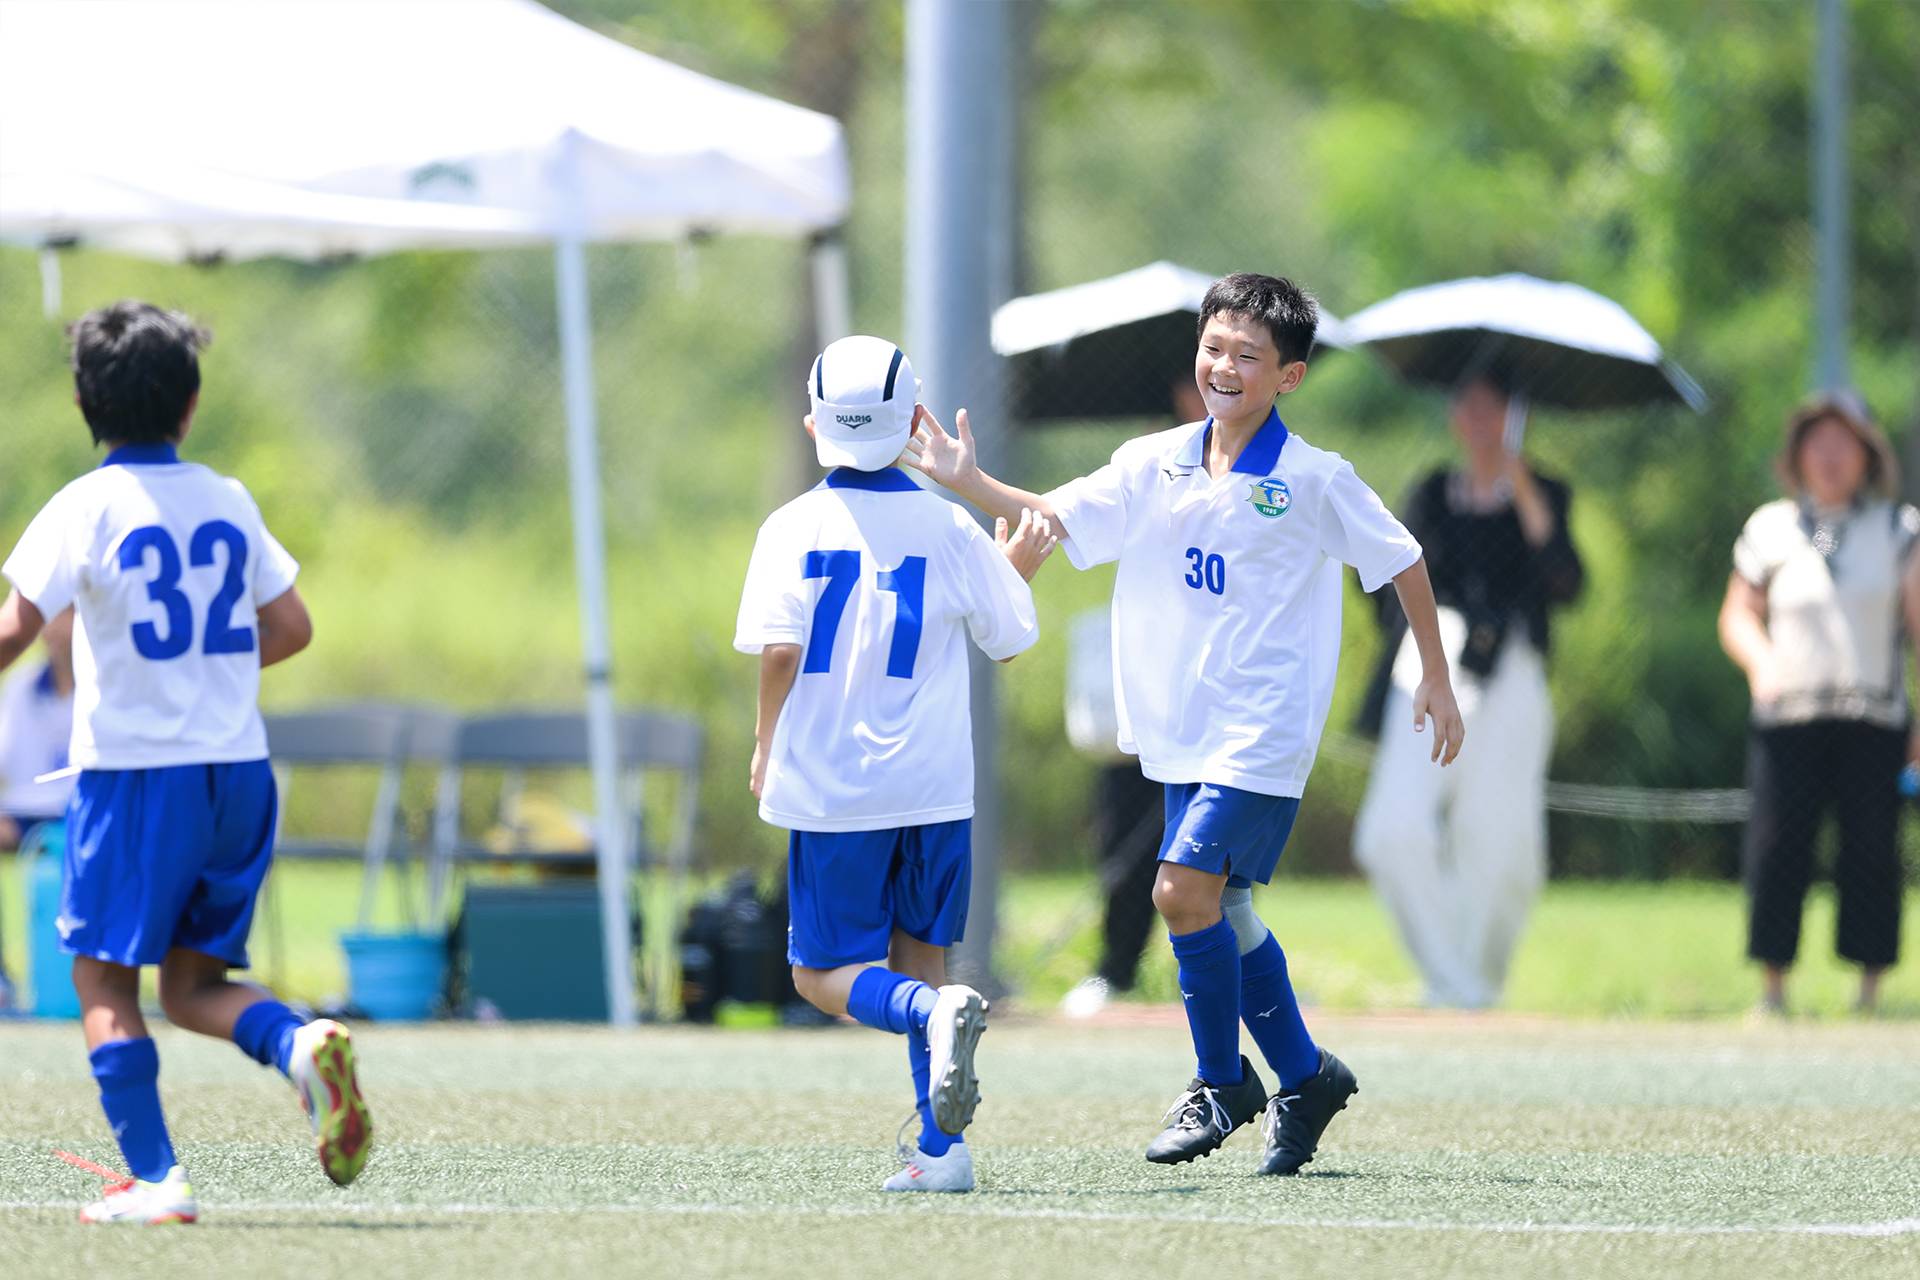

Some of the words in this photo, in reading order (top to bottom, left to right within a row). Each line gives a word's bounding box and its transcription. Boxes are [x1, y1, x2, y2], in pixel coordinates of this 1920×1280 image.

[835, 414, 872, 423] DUARIG
[118, 520, 256, 661] 32
[803, 550, 927, 679] 71
[1184, 547, 1226, 596] 30
